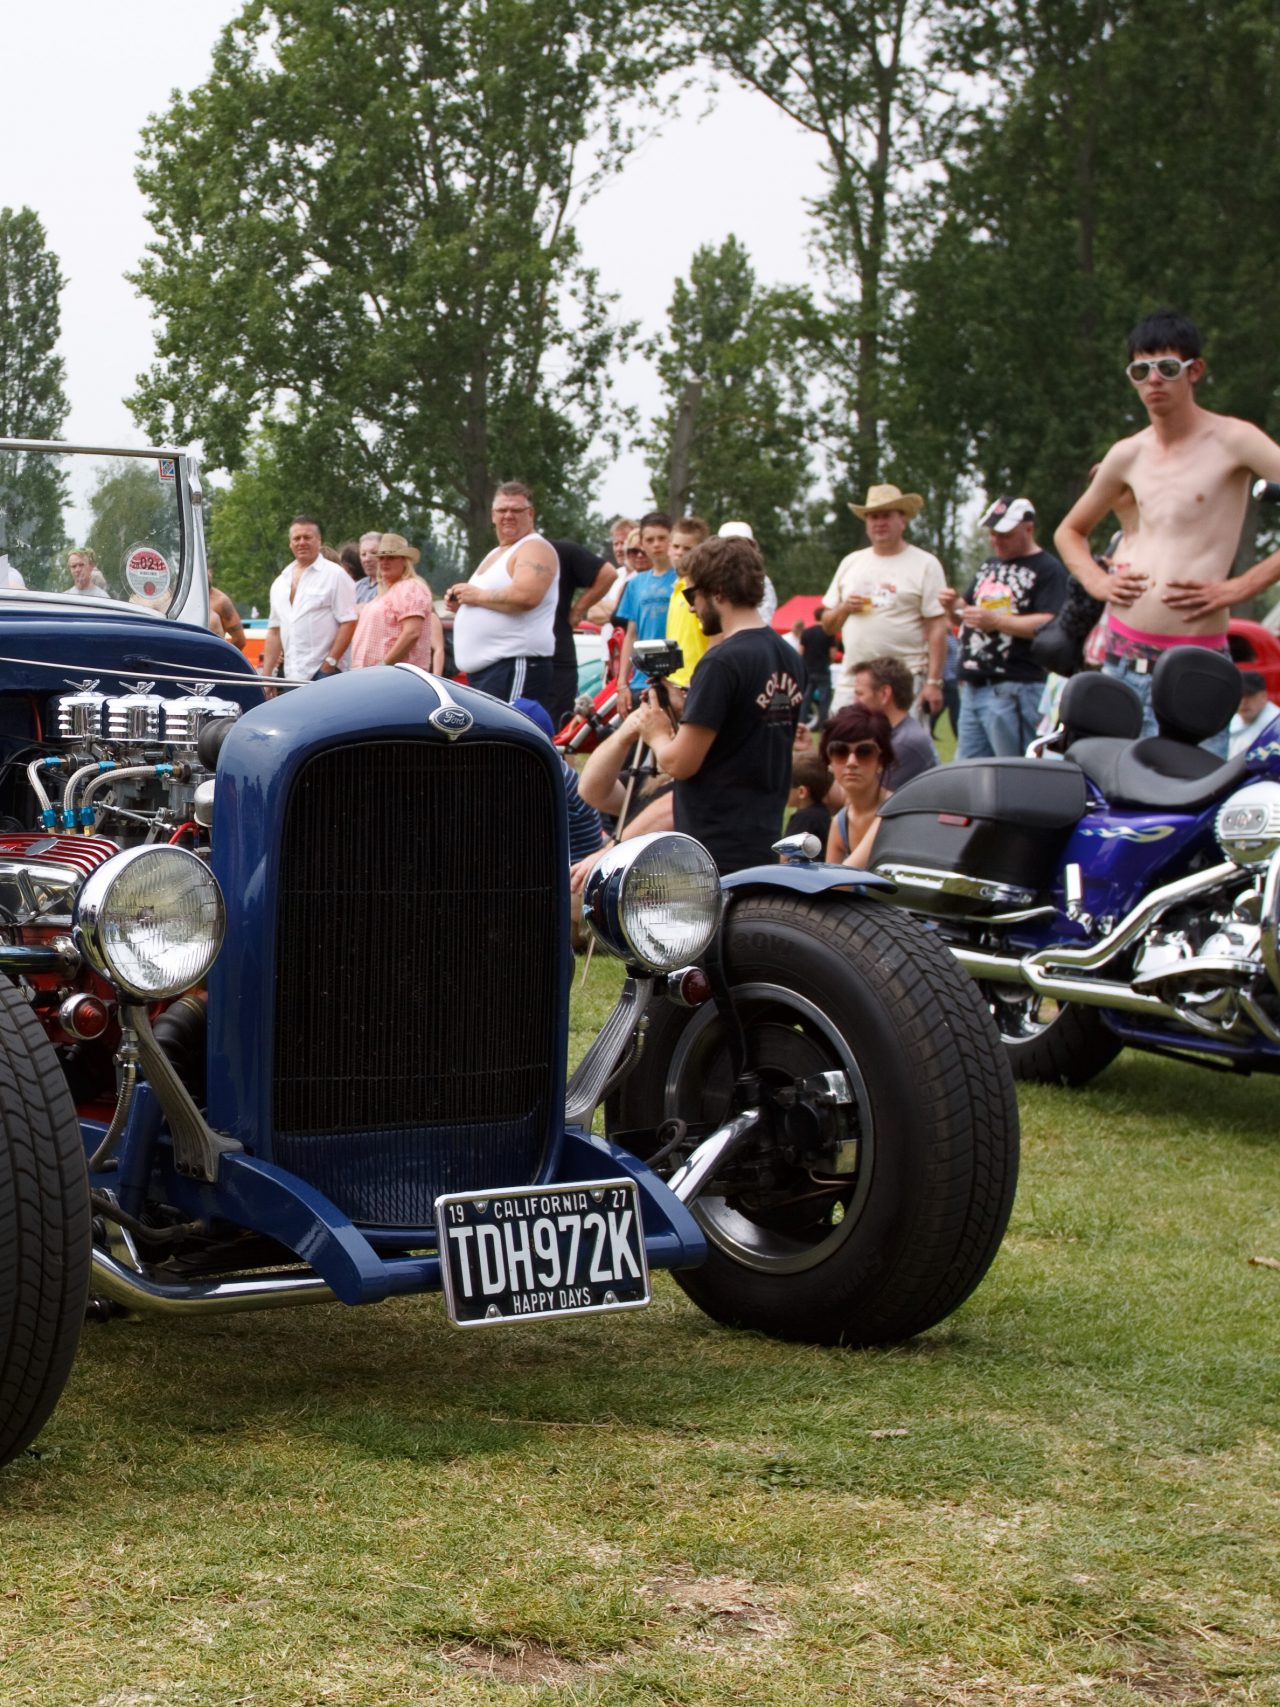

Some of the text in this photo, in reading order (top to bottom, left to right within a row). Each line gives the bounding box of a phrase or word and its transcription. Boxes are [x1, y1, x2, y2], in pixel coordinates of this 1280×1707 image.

[140, 557, 154, 570] 02
[443, 710, 466, 725] Ford
[448, 1189, 627, 1224] 19 CALIFORNIA 27
[448, 1210, 641, 1298] TDH972K
[513, 1287, 591, 1314] HAPPY DAYS
